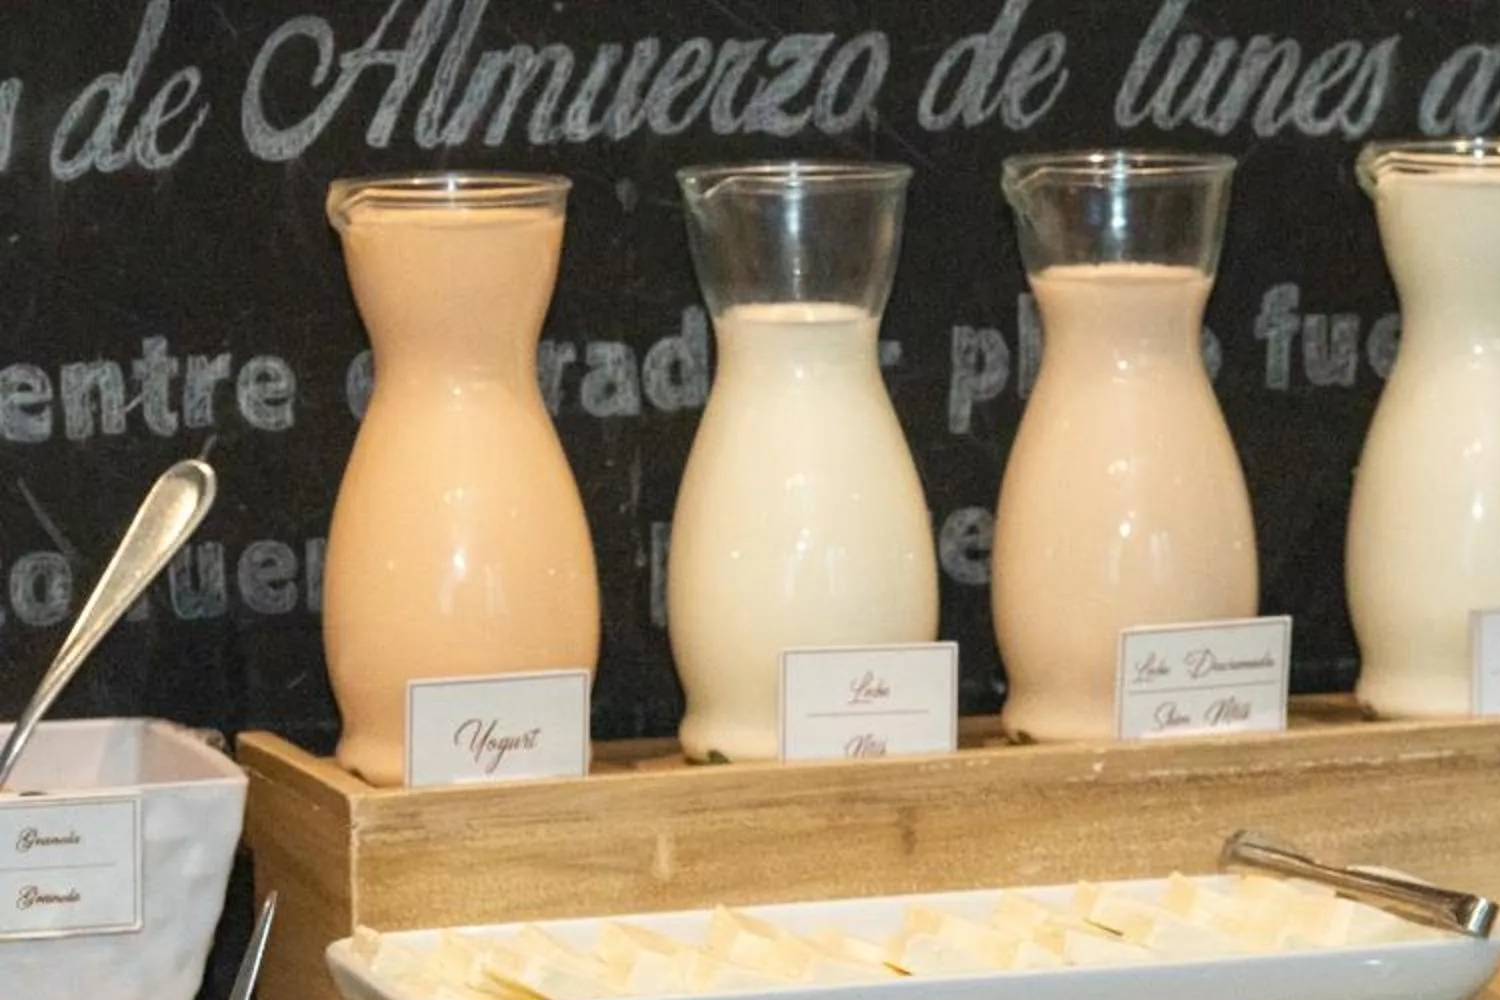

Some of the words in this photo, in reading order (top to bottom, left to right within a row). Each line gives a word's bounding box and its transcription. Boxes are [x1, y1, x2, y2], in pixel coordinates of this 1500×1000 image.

[50, 0, 211, 182] de
[240, 0, 893, 164] Almuerzo
[917, 0, 1070, 132] de
[1114, 0, 1398, 138] lunes
[0, 336, 296, 443] entre
[453, 717, 541, 774] Yogurt
